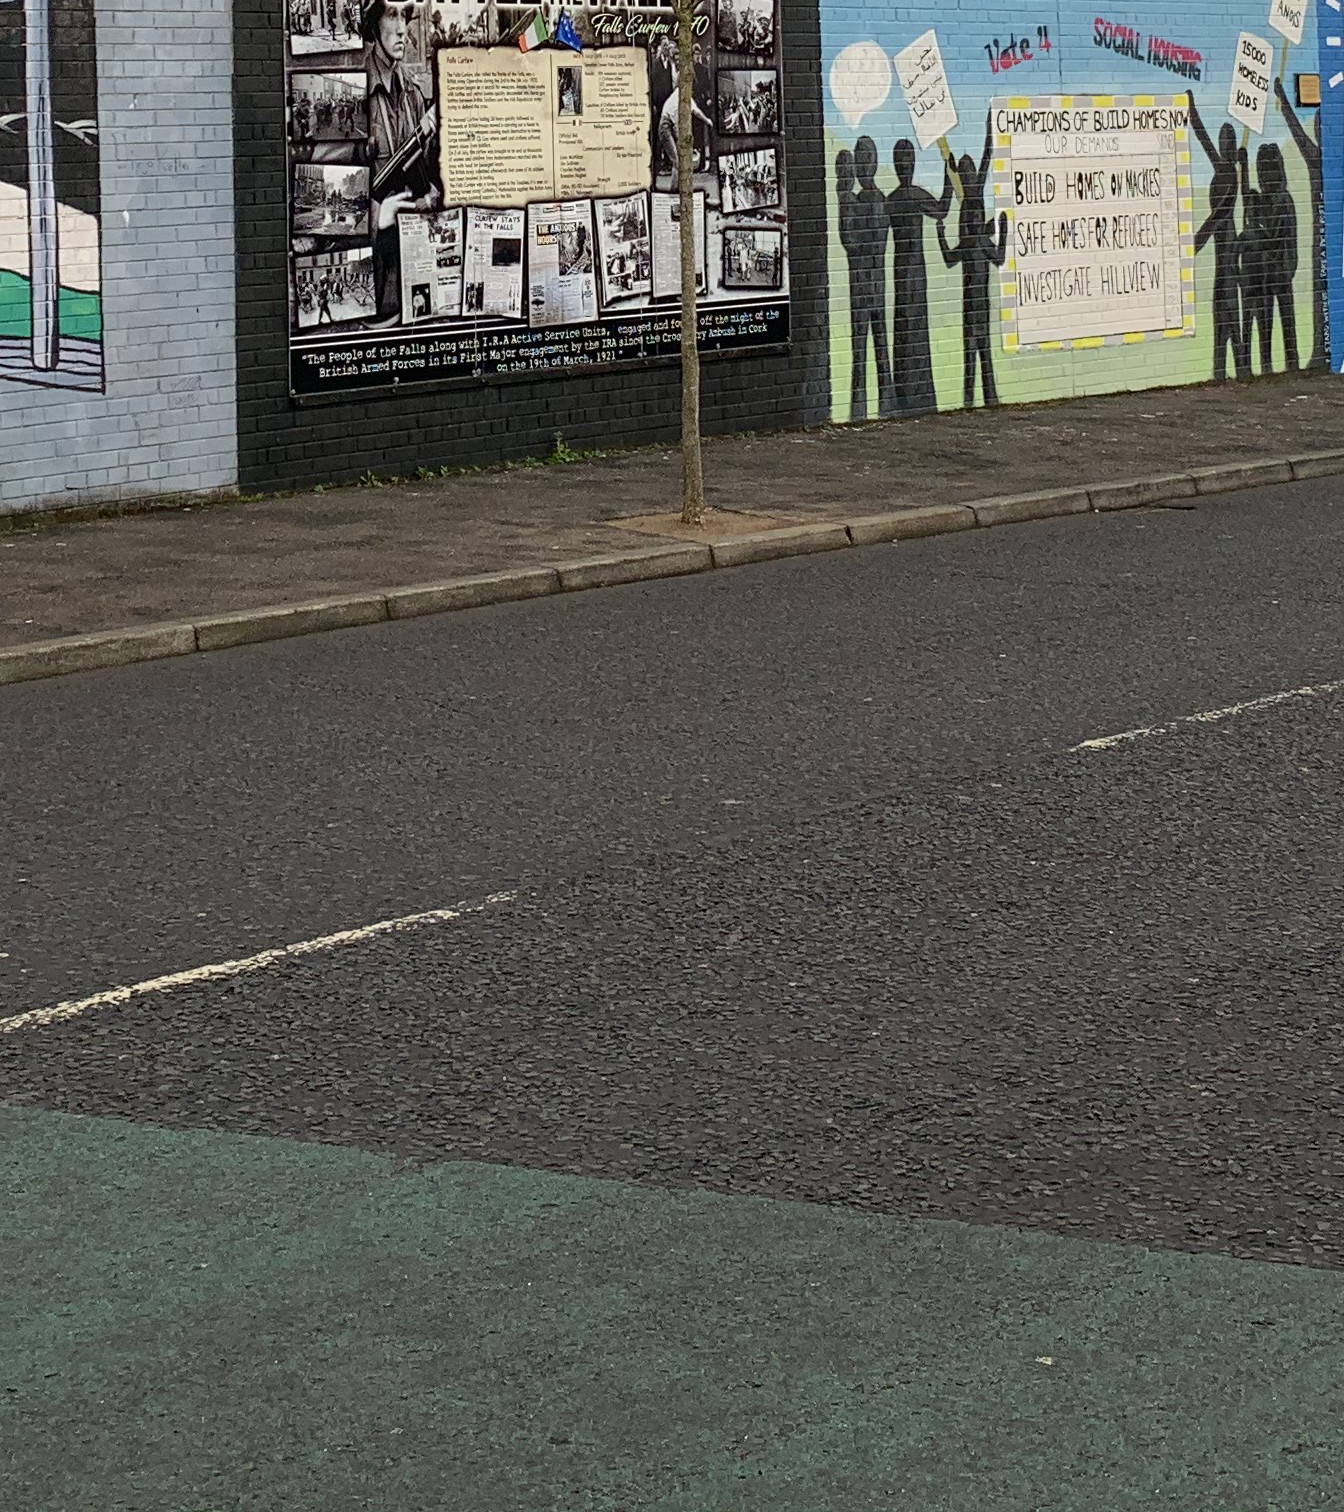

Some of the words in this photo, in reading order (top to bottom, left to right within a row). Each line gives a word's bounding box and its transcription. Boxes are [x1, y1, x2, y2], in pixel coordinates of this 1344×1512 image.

[592, 13, 624, 37] Falls
[625, 14, 671, 44] Curfew
[672, 15, 711, 37] 170
[1092, 17, 1145, 62] SOCIAL
[983, 32, 1034, 76] Vote
[1036, 25, 1052, 53] 4
[1241, 39, 1267, 66] 15000
[1238, 61, 1269, 92] HOMELESS
[1235, 89, 1258, 112] KIDS
[996, 109, 1071, 134] CHAMPIONS
[1073, 110, 1090, 132] OF
[1093, 108, 1130, 131] BUILD
[1132, 108, 1169, 130] HOMES
[1168, 107, 1190, 129] NOW
[1044, 134, 1067, 154] OUR
[1013, 171, 1056, 205] BUILD
[1066, 170, 1105, 201] HOMES
[1017, 220, 1048, 257] SAFE
[1052, 216, 1086, 250] HOMES
[1088, 216, 1110, 249] FOR
[1112, 212, 1159, 251] REFUGEES
[1017, 265, 1092, 307] INVESTIGATE
[1100, 261, 1160, 295] HILLVIEW
[319, 365, 359, 378] British
[361, 361, 390, 374] Armed
[392, 358, 426, 370] Forces
[428, 355, 440, 366] in
[442, 354, 458, 365] its
[459, 350, 487, 363] First
[489, 347, 516, 362] Major
[518, 342, 568, 358] engagement
[570, 340, 582, 354] by
[584, 339, 600, 350] the
[601, 337, 618, 349] IRA
[618, 335, 643, 347] since
[645, 333, 661, 344] the
[708, 326, 736, 338] Ambush
[737, 325, 747, 335] in
[748, 323, 768, 335] Cork
[328, 350, 362, 364] People
[366, 349, 377, 359] of
[379, 347, 397, 358] the
[399, 344, 426, 356] Falls
[428, 341, 456, 354] along
[458, 338, 480, 350] with
[511, 332, 542, 345] Active
[544, 328, 581, 342] Service
[617, 322, 652, 335] engaged
[653, 320, 669, 331] and
[699, 314, 712, 325] off
[714, 313, 729, 324] the
[730, 311, 754, 324] night
[755, 310, 764, 321] of
[765, 309, 780, 320] the
[496, 362, 508, 372] on
[510, 360, 527, 371] the
[528, 358, 550, 370] 19th
[552, 355, 563, 366] of
[563, 353, 594, 366] March,
